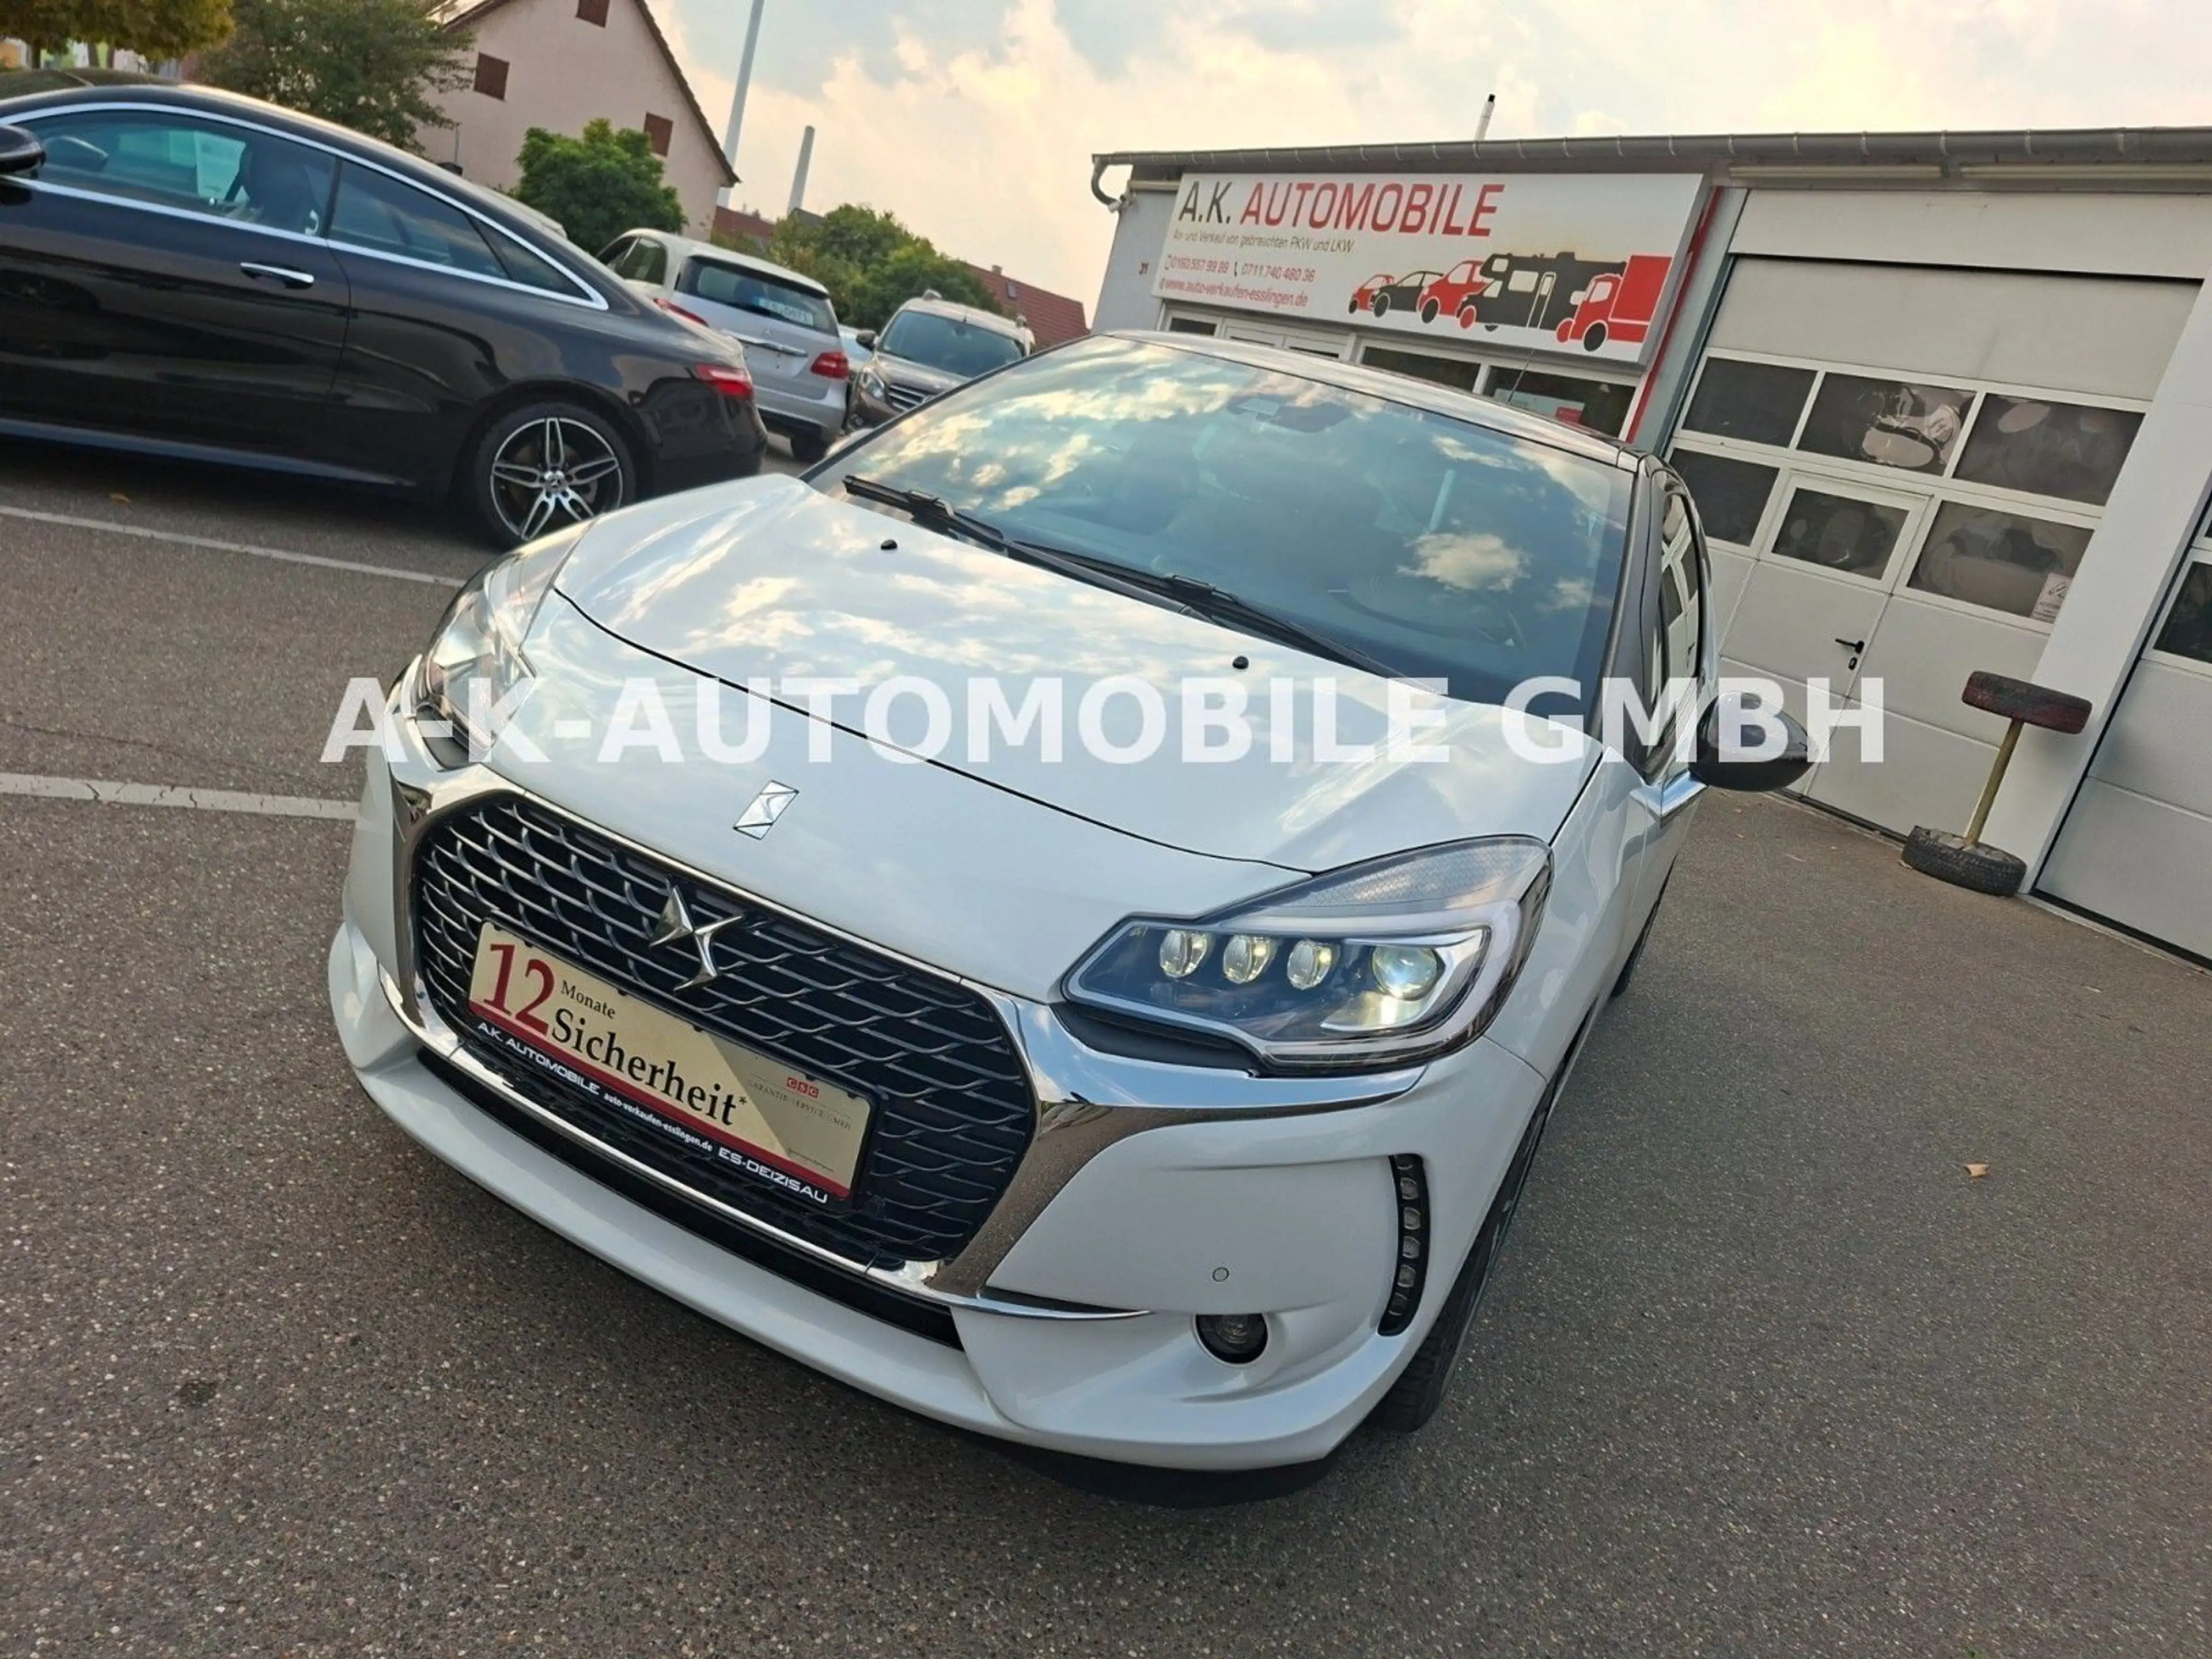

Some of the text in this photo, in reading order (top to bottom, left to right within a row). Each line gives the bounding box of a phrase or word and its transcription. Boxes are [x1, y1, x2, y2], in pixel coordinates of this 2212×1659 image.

[1178, 180, 1505, 237] A.K. AUTOMOBILE
[1291, 236, 1313, 251] PKW
[1313, 239, 1330, 252] und
[1330, 238, 1355, 253] LKW
[484, 944, 554, 1037] 12
[560, 979, 616, 1019] Monate
[506, 1037, 600, 1095] AUTOMOBILE
[603, 1093, 713, 1153] auto-verkaufen-esslingen.de
